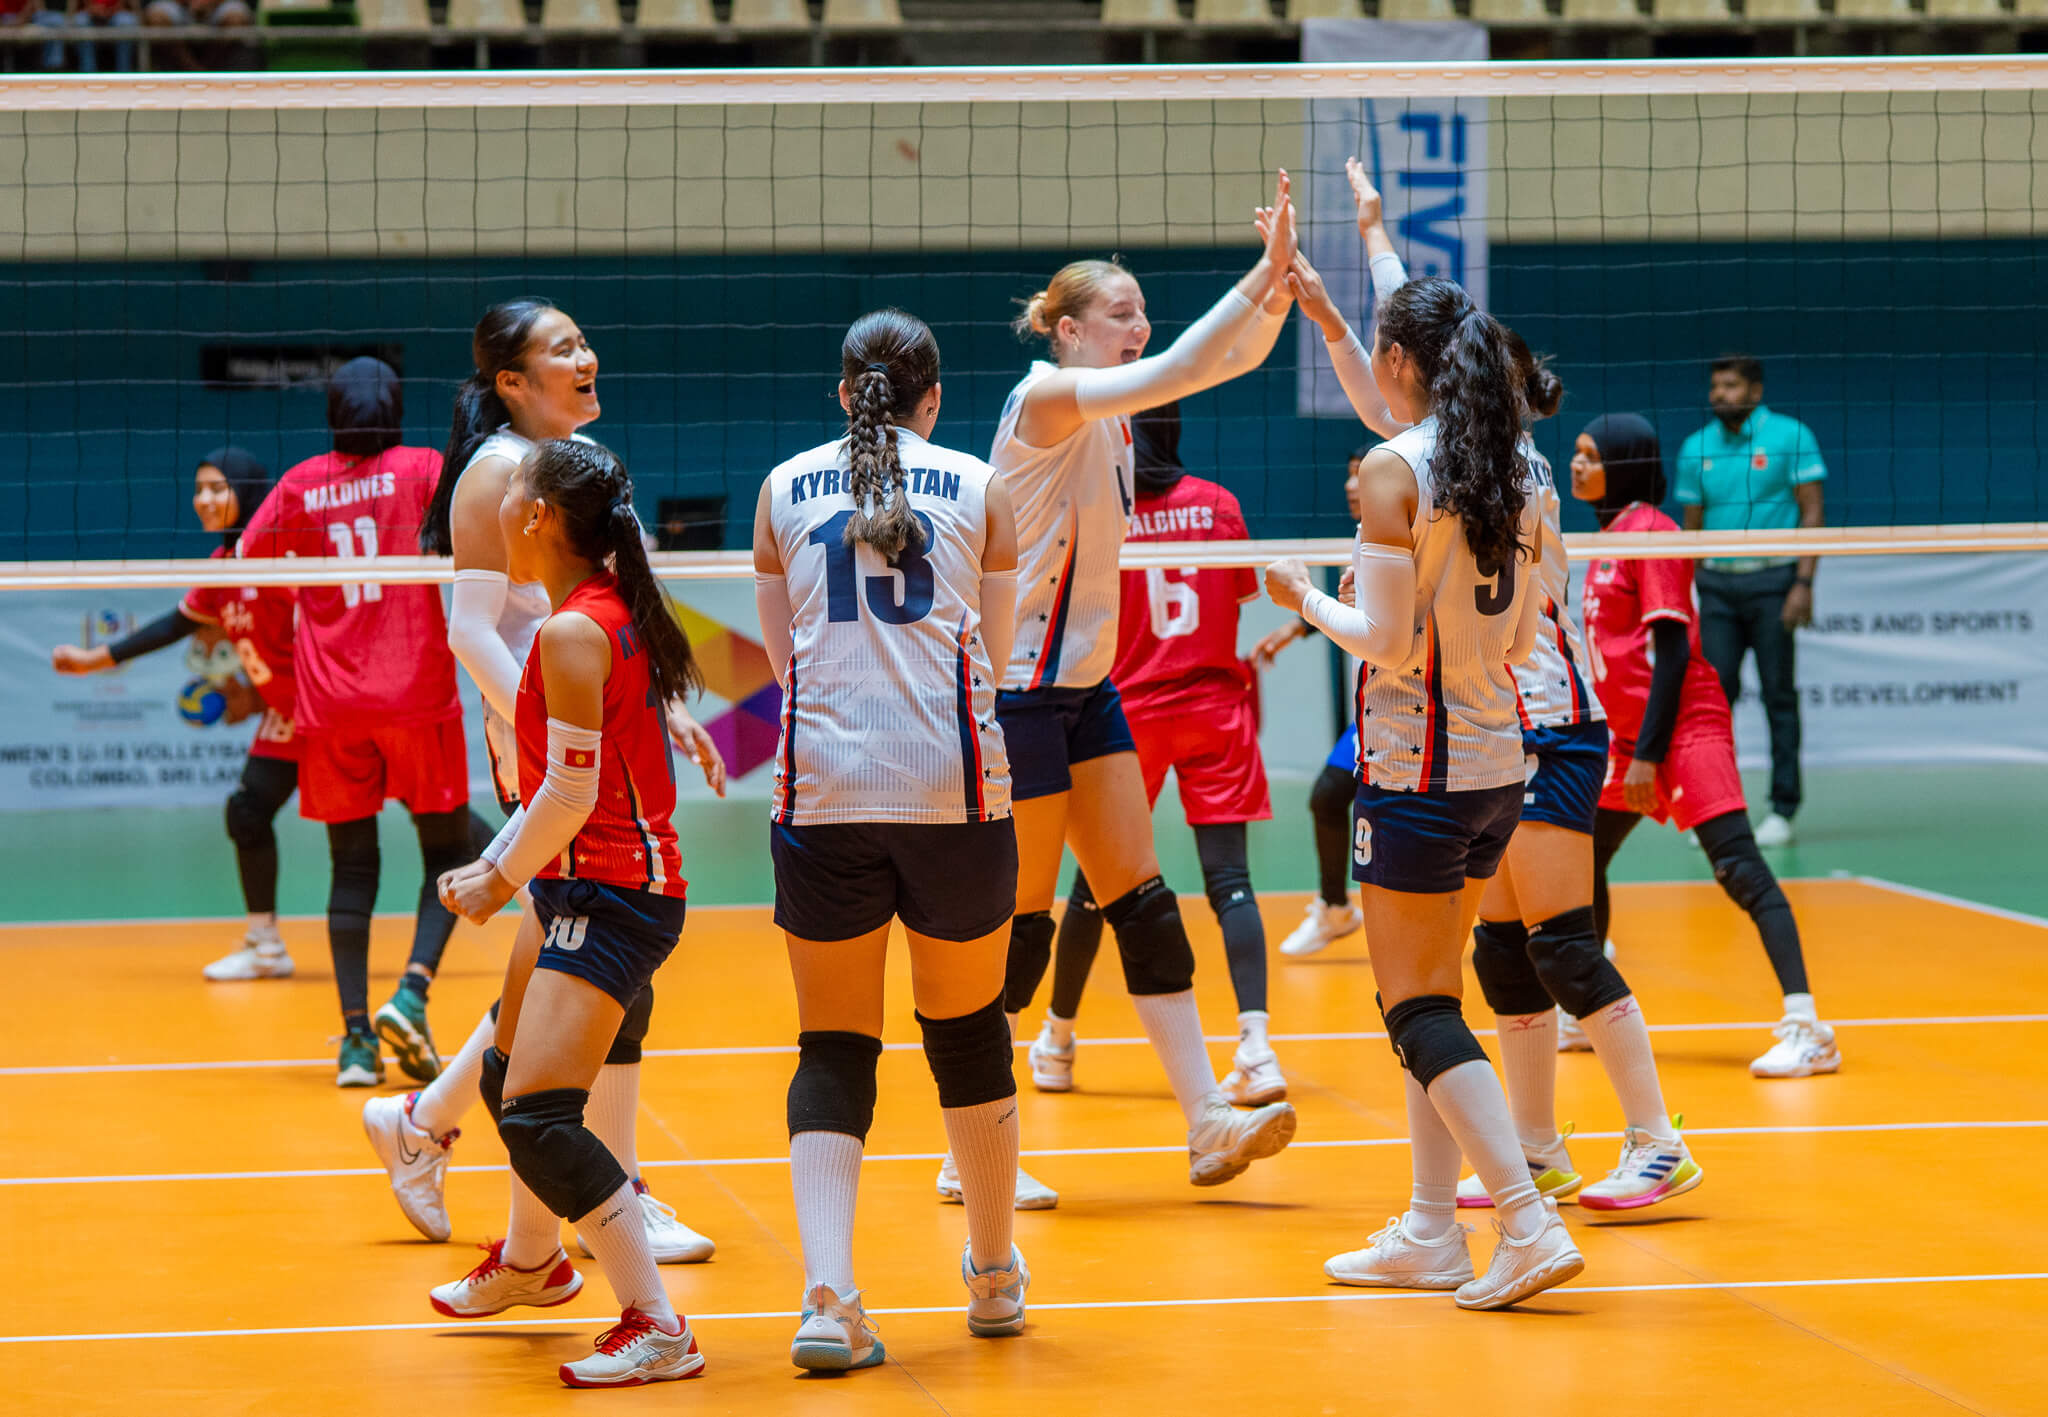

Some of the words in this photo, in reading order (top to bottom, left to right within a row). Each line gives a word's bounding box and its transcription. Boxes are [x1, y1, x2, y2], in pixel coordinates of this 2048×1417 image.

[303, 472, 396, 513] MALDIVES
[1127, 506, 1214, 537] ALDIVES
[809, 510, 935, 625] 13
[1870, 613, 1924, 634] AND
[1932, 610, 2032, 634] SPORTS
[1830, 681, 2019, 706] DEVELOPMENT
[1354, 817, 1373, 866] 9
[544, 914, 589, 950] 10
